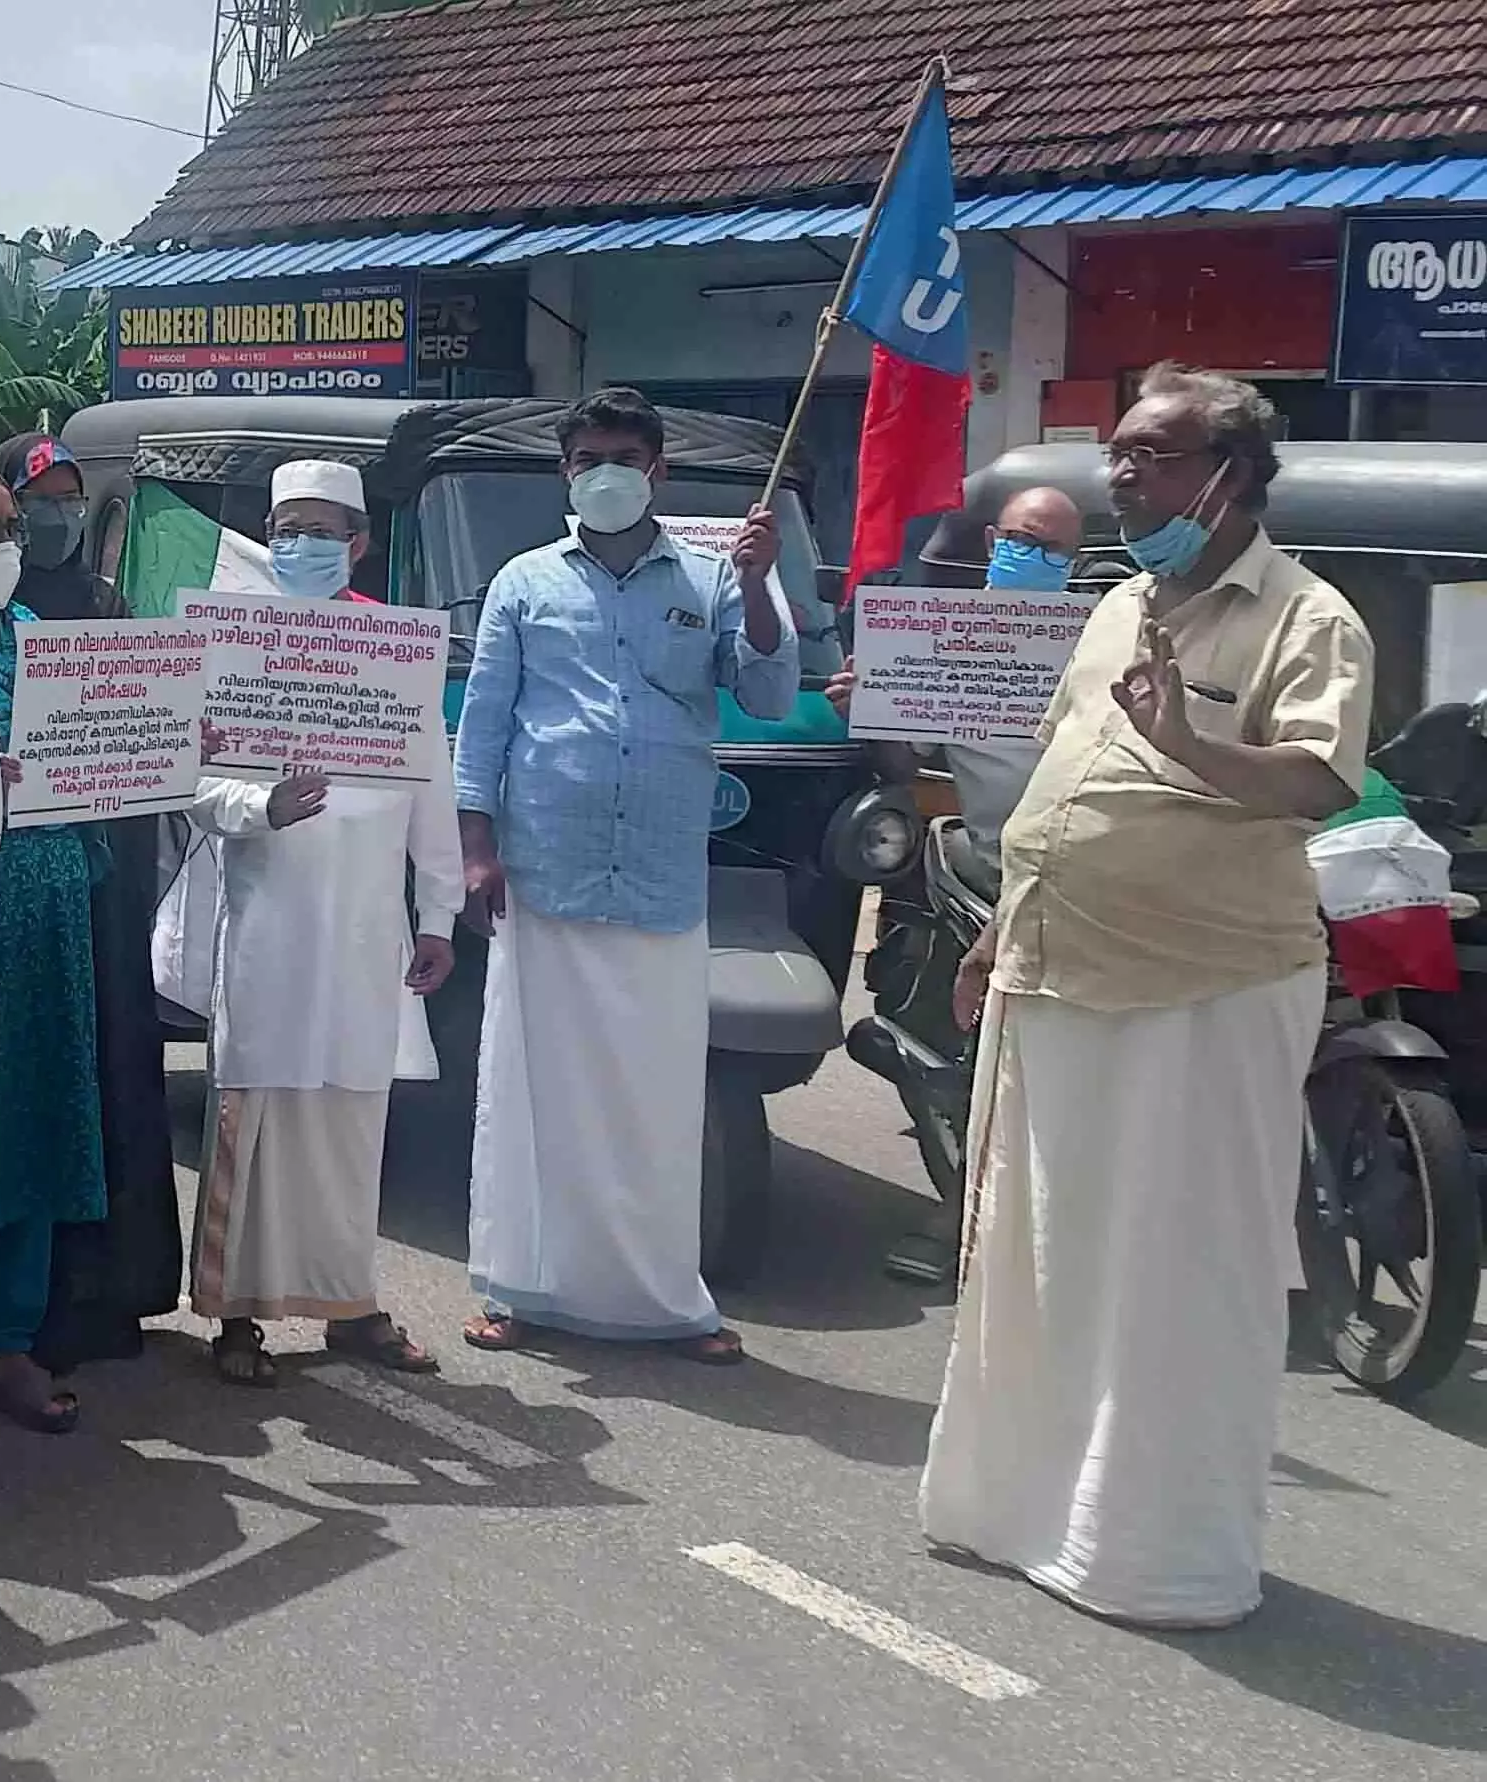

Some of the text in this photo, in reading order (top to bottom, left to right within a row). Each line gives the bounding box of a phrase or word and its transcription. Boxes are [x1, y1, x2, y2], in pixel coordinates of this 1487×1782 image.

[119, 298, 404, 346] SHABEER RUBBER TRADERS
[136, 370, 382, 395] റബ്ബർ വ്യാപാരം
[184, 603, 247, 622] ഇന്ധന
[24, 636, 70, 659] ഇന്ധന
[26, 655, 94, 681] തൊഴിലാളി
[264, 653, 359, 677] പ്രതിഷേധം
[952, 727, 989, 742] FITU
[93, 797, 122, 813] FITU
